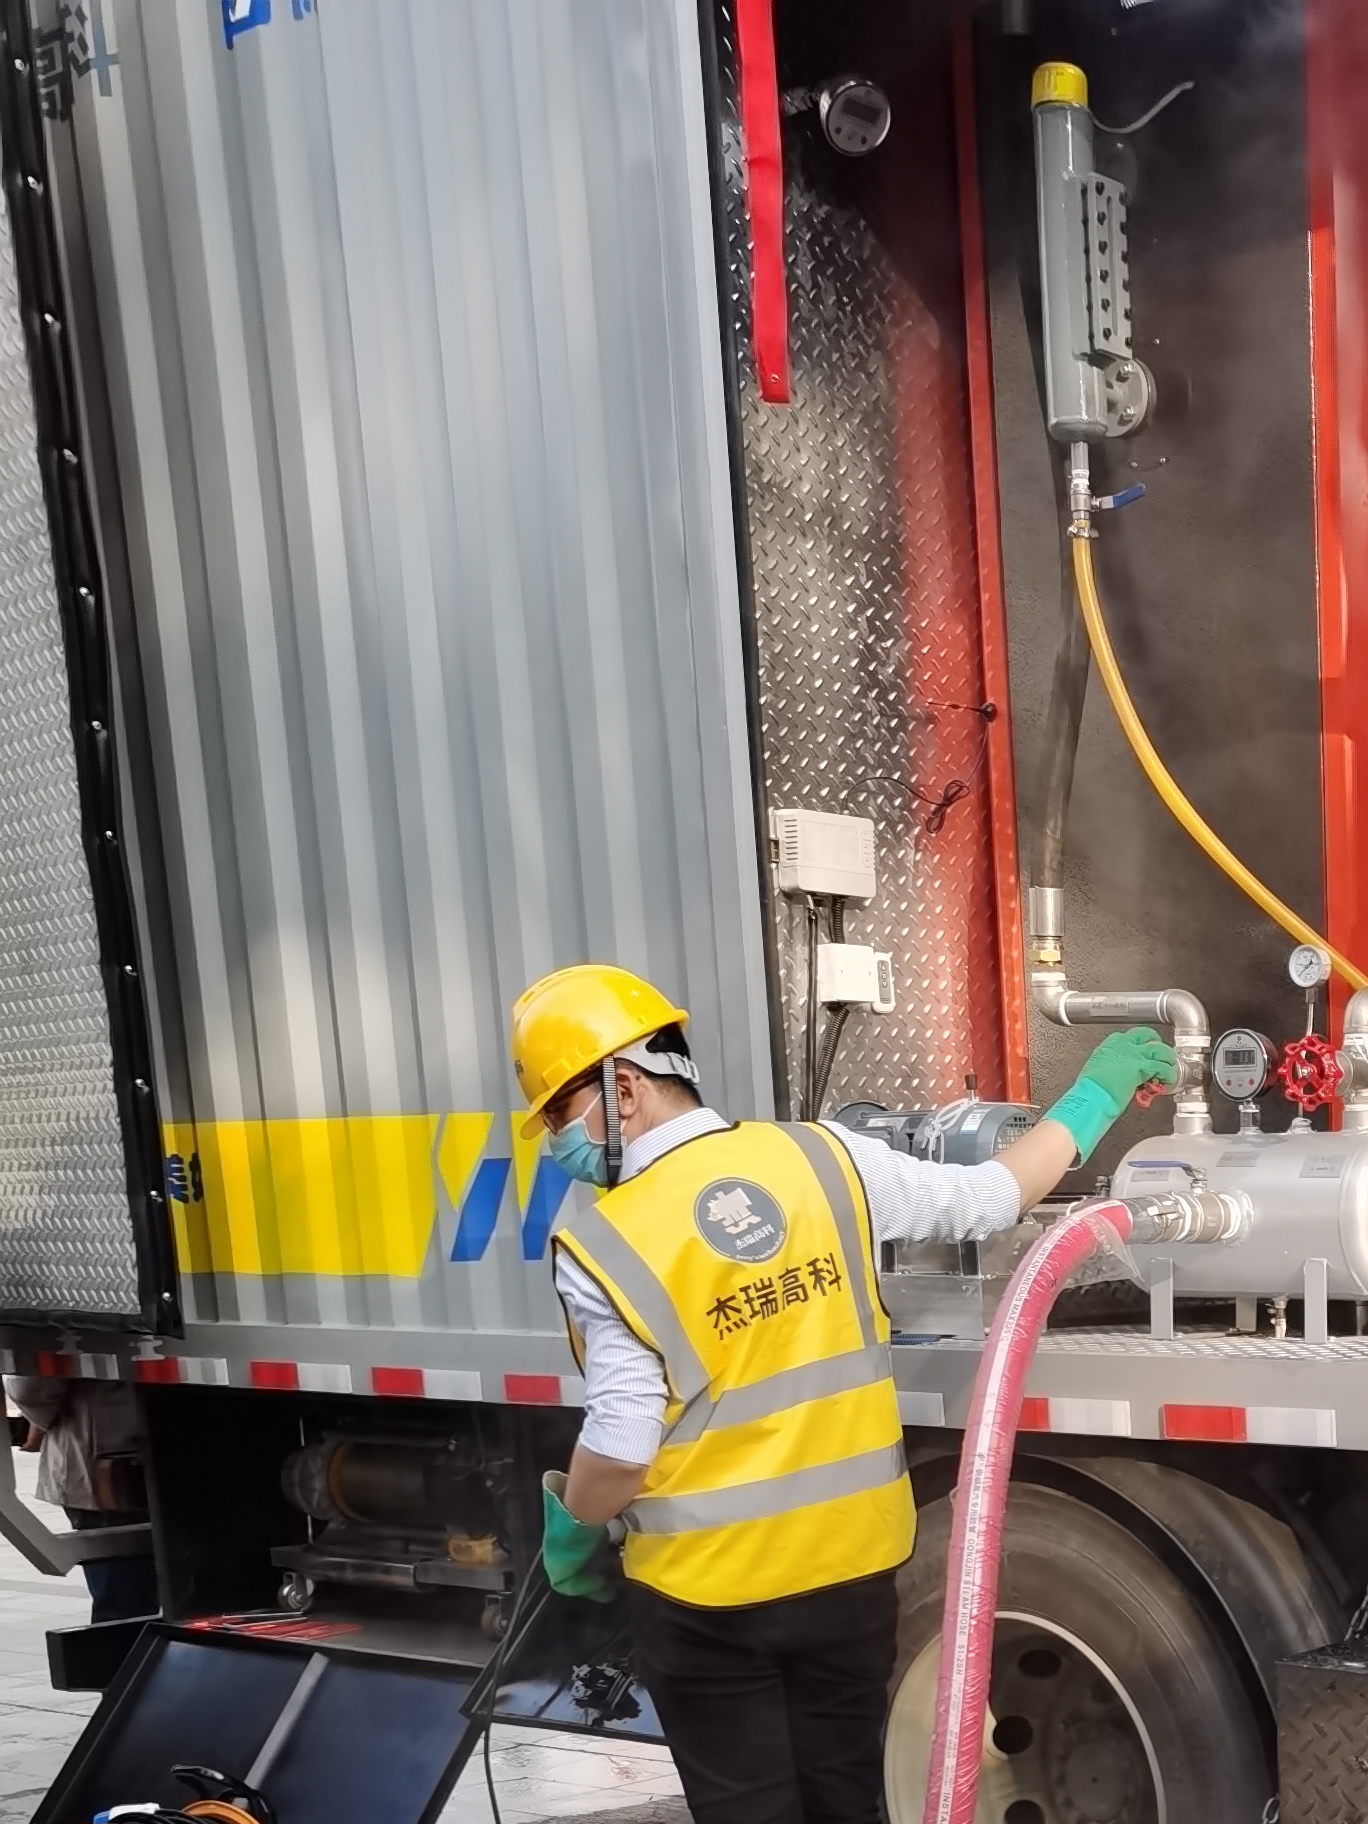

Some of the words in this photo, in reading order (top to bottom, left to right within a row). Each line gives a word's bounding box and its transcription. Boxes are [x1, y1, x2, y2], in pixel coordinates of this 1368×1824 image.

[706, 1252, 842, 1341] 杰瑞高科
[964, 1537, 976, 1578] DONGJIN
[961, 1578, 972, 1610] STEAM
[958, 1611, 968, 1637] HOSE
